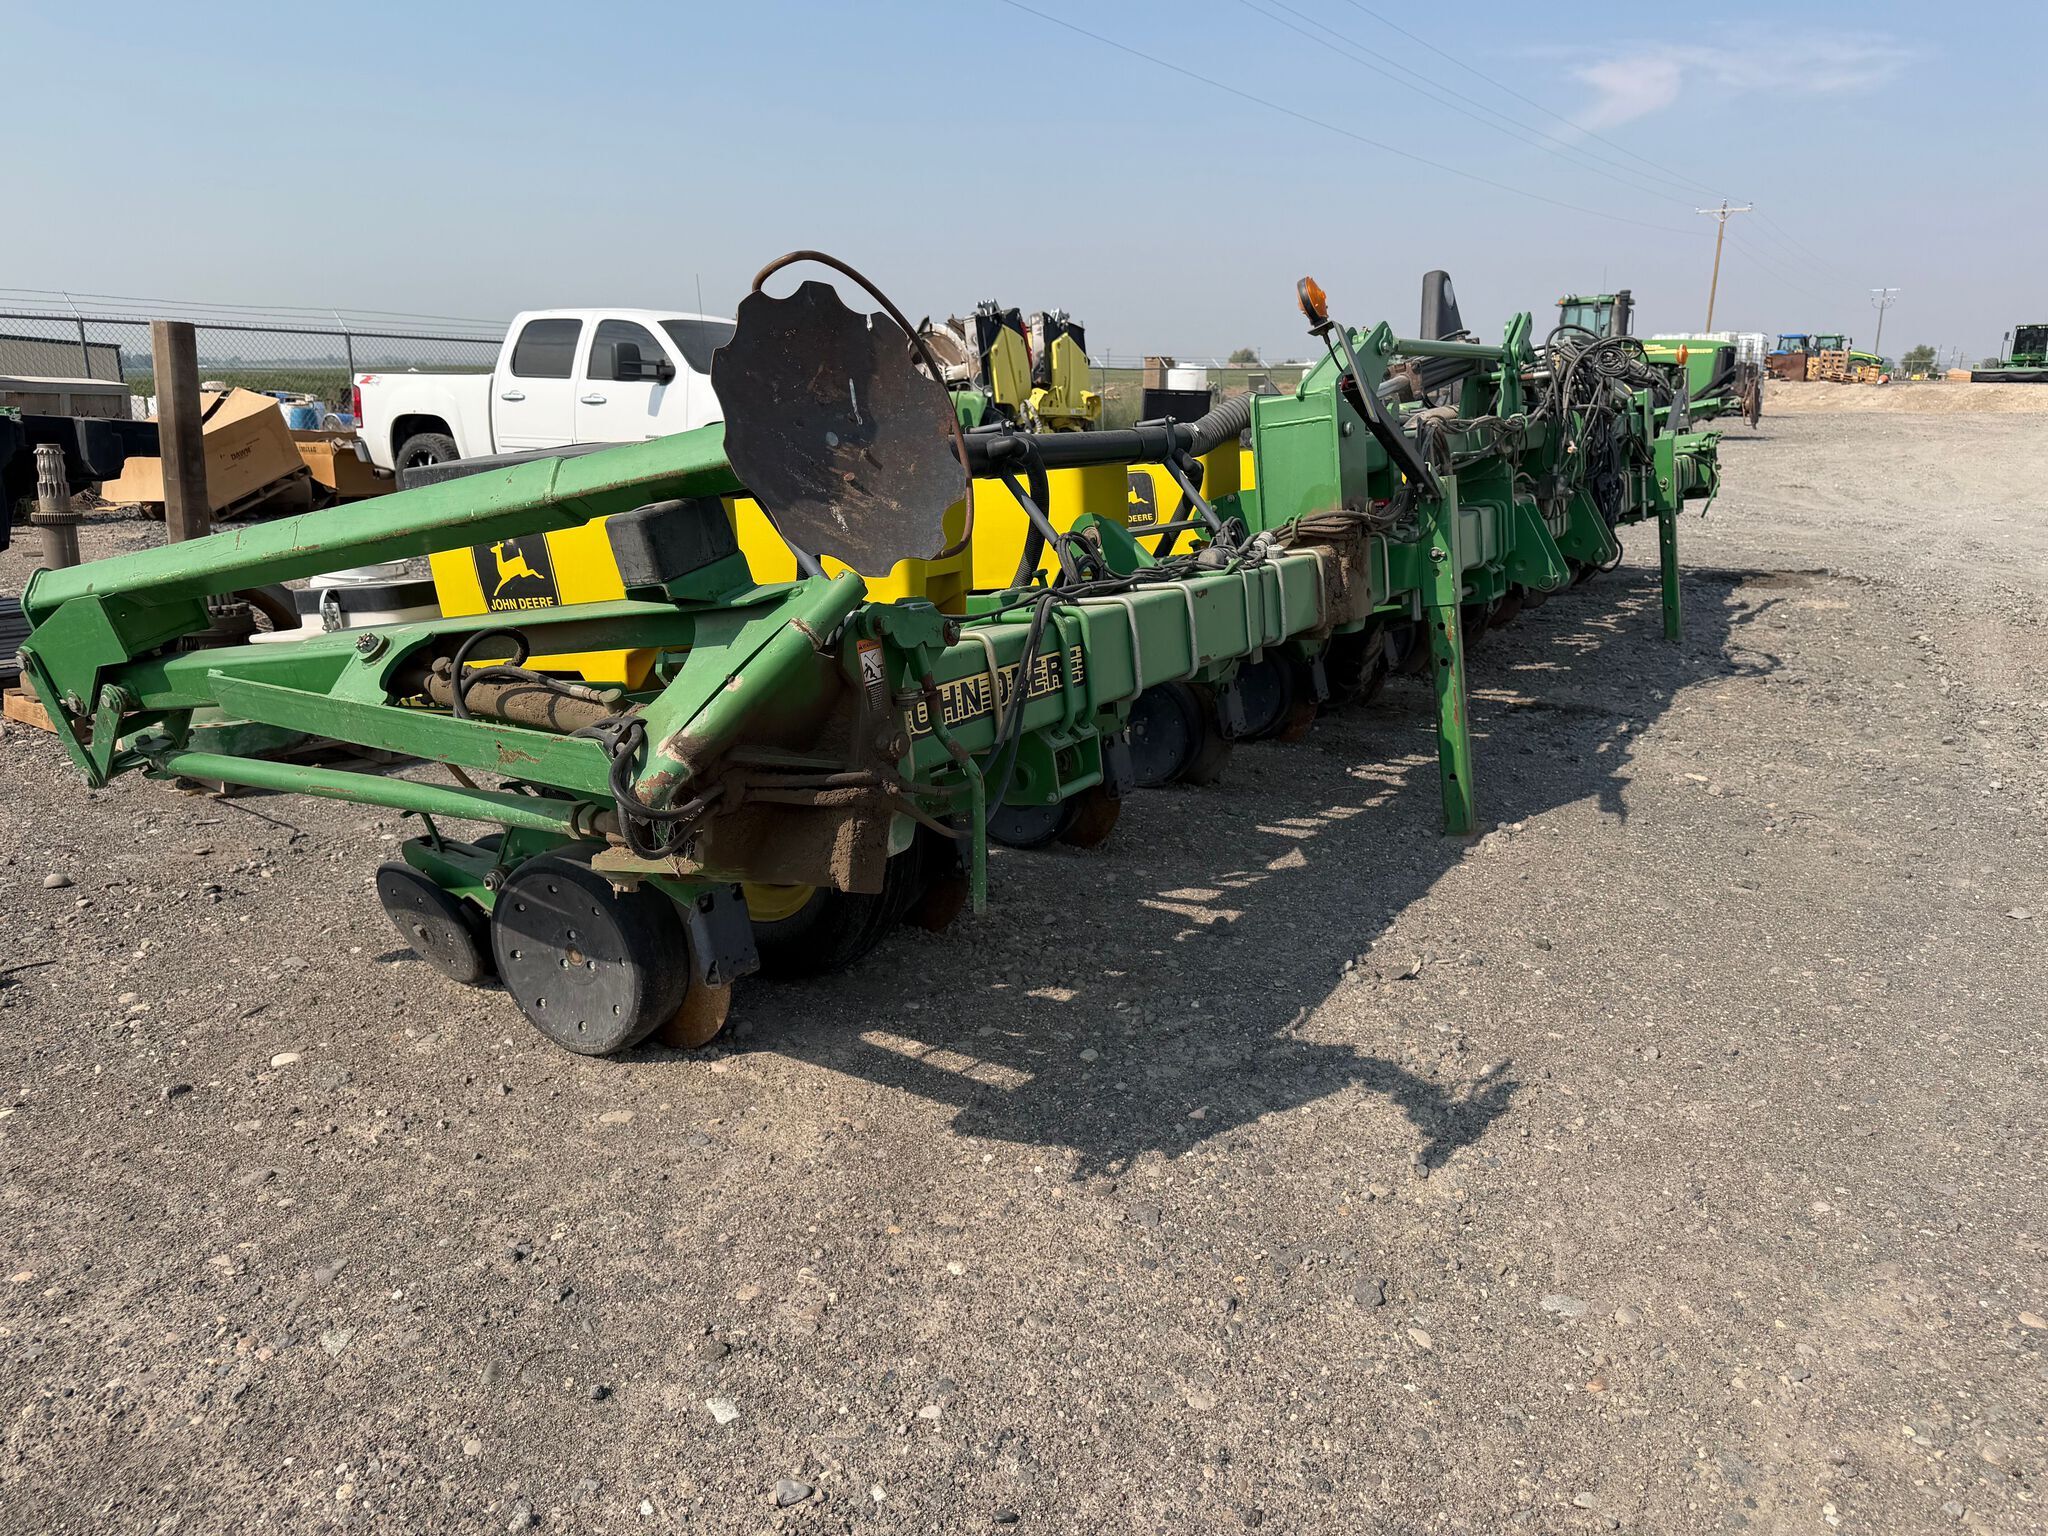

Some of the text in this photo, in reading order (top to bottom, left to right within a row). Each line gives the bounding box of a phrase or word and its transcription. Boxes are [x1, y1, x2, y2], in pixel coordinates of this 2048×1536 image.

[491, 596, 555, 611] JOHN DEERE
[908, 674, 986, 735] OHN
